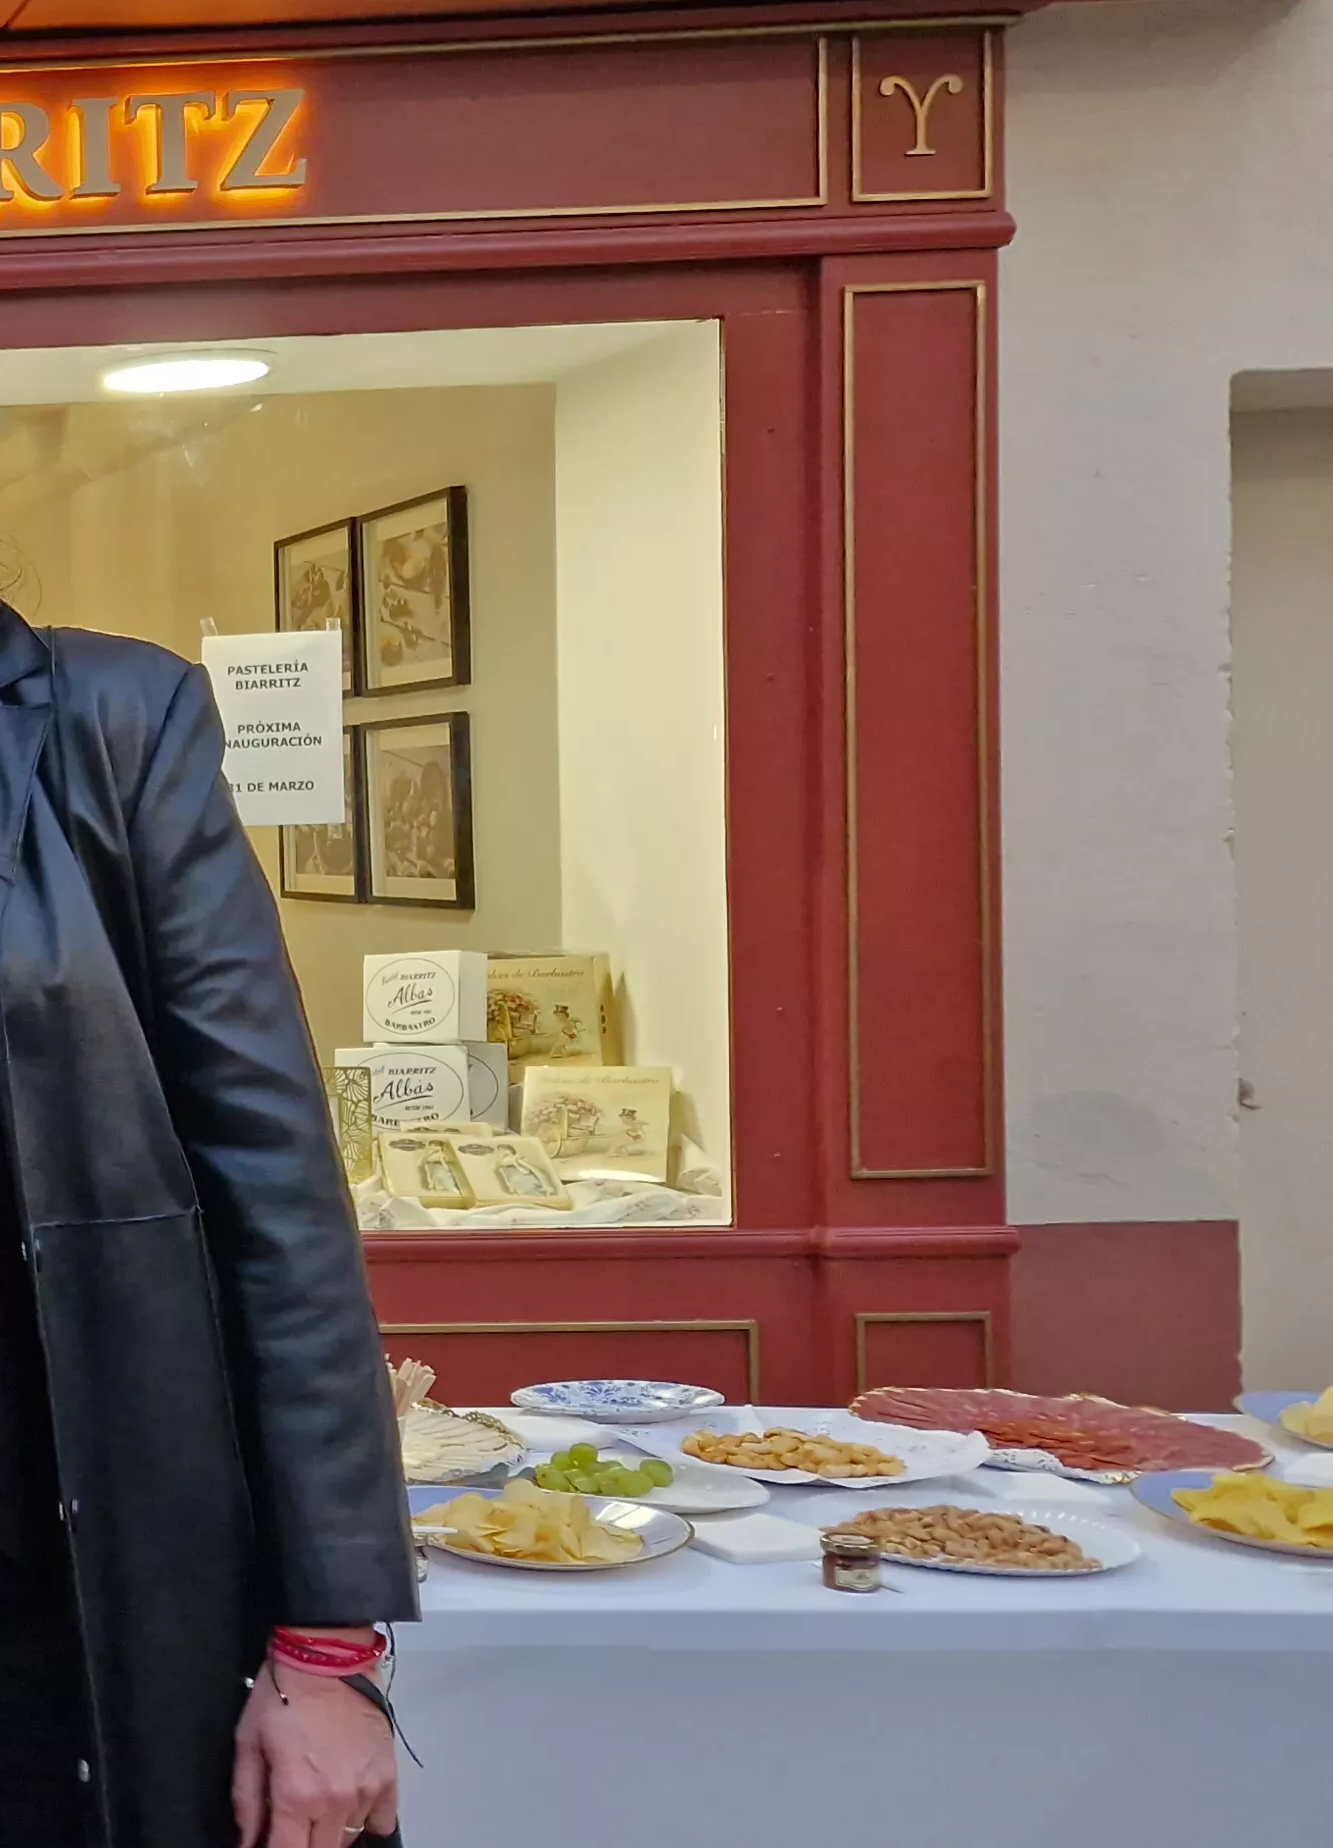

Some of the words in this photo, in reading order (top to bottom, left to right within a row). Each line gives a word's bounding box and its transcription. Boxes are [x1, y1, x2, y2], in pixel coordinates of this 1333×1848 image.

[227, 660, 309, 675] PASTELERÍA
[235, 678, 302, 690] BIARRITZ
[237, 721, 302, 734] PRÓXIMA
[225, 734, 322, 748] NAUGURACIÓN
[247, 782, 265, 793] DE
[268, 780, 315, 792] MARZO
